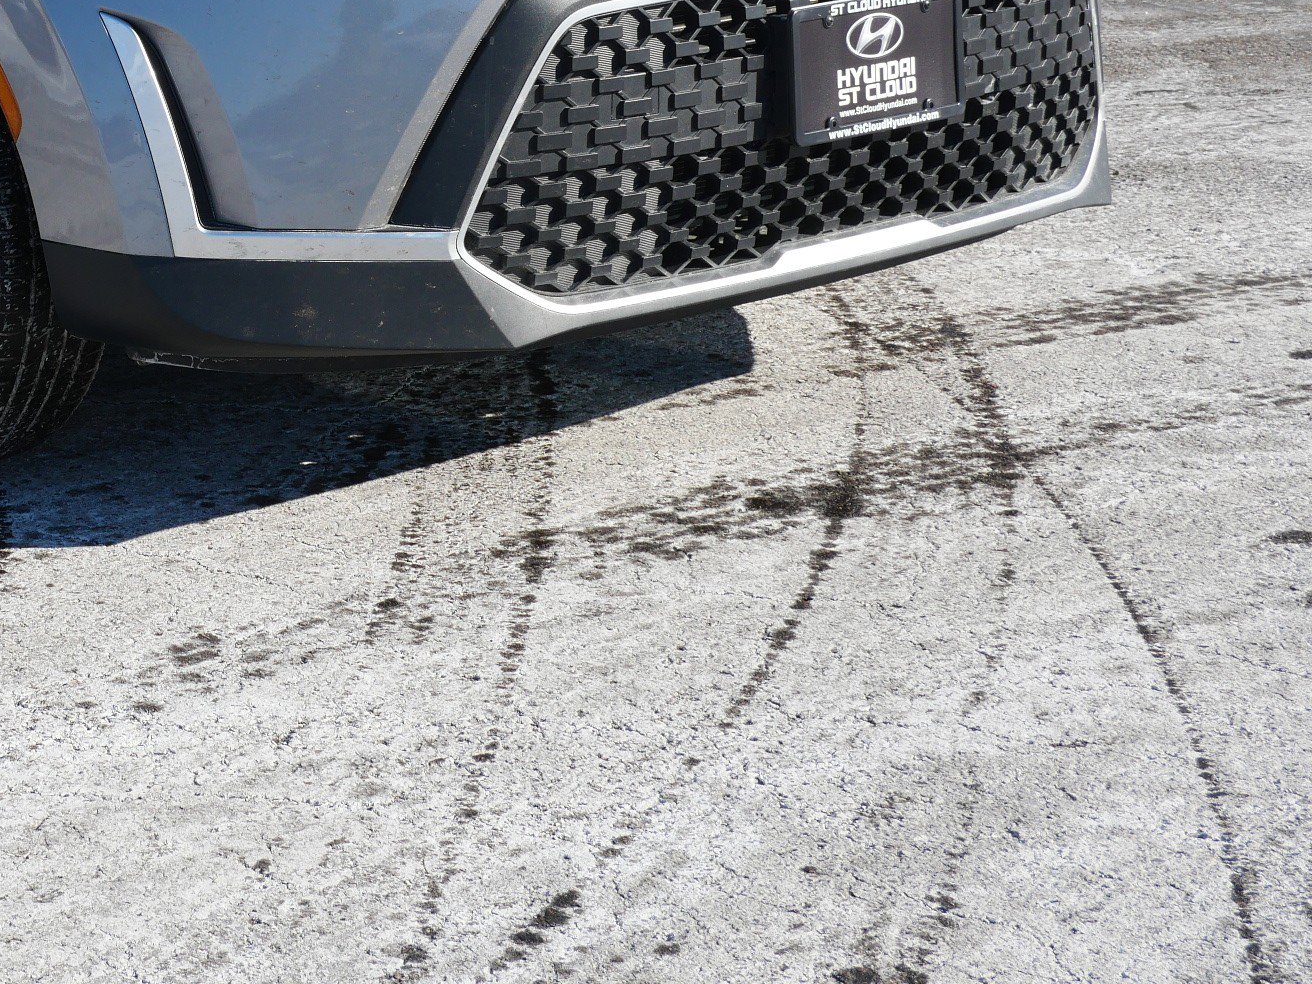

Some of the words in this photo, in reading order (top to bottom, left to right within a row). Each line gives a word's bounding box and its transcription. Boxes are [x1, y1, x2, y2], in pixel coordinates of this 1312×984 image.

[830, 3, 846, 17] ST
[836, 56, 917, 89] HYUNDAI
[838, 87, 860, 107] ST
[865, 76, 917, 101] CLOUD
[839, 97, 918, 118] www.StCloudHyundai.com
[828, 110, 940, 140] www.StCloudHyundai.com
